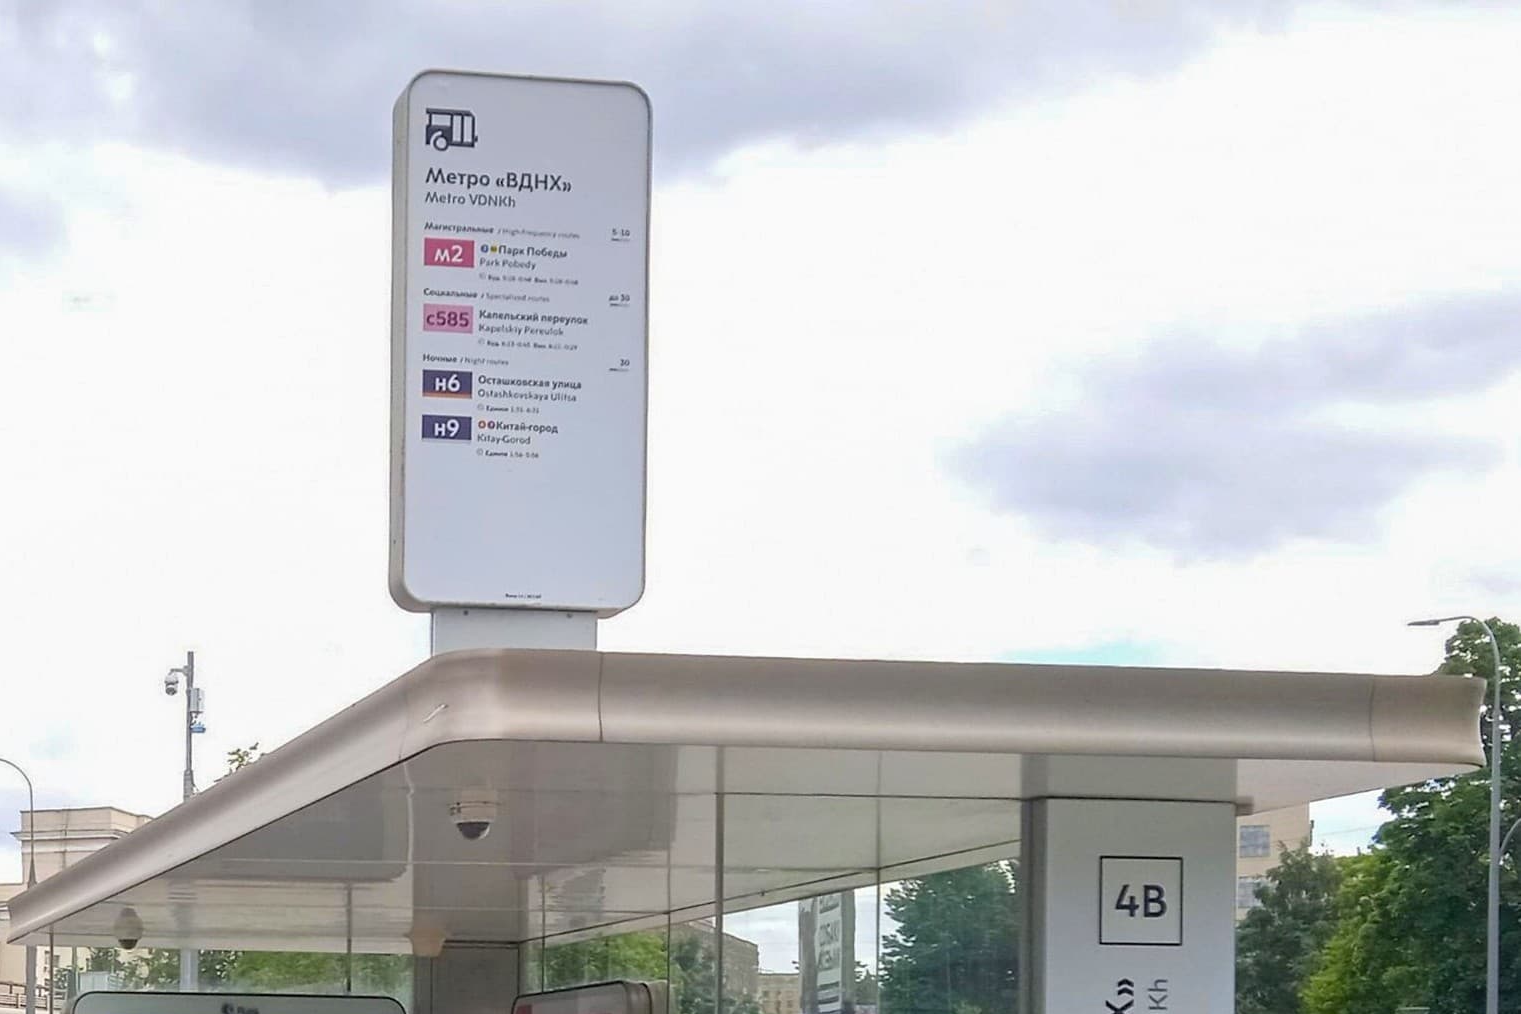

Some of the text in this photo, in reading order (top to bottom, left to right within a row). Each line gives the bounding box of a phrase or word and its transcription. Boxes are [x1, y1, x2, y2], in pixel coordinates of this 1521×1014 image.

[425, 167, 572, 193] Метро «ВДНХ»
[425, 191, 516, 208] Metro VDNKh
[611, 228, 631, 237] 510
[498, 245, 568, 259] Парк Победы
[479, 257, 500, 267] Park
[479, 309, 539, 322] Капельский
[422, 353, 458, 364] Ночные
[478, 374, 582, 391] Осташковская улица
[477, 388, 578, 403] Ostashkovskaya Ulitsa
[496, 420, 559, 434] Китай-город
[477, 433, 531, 445] Kitay-Gorod
